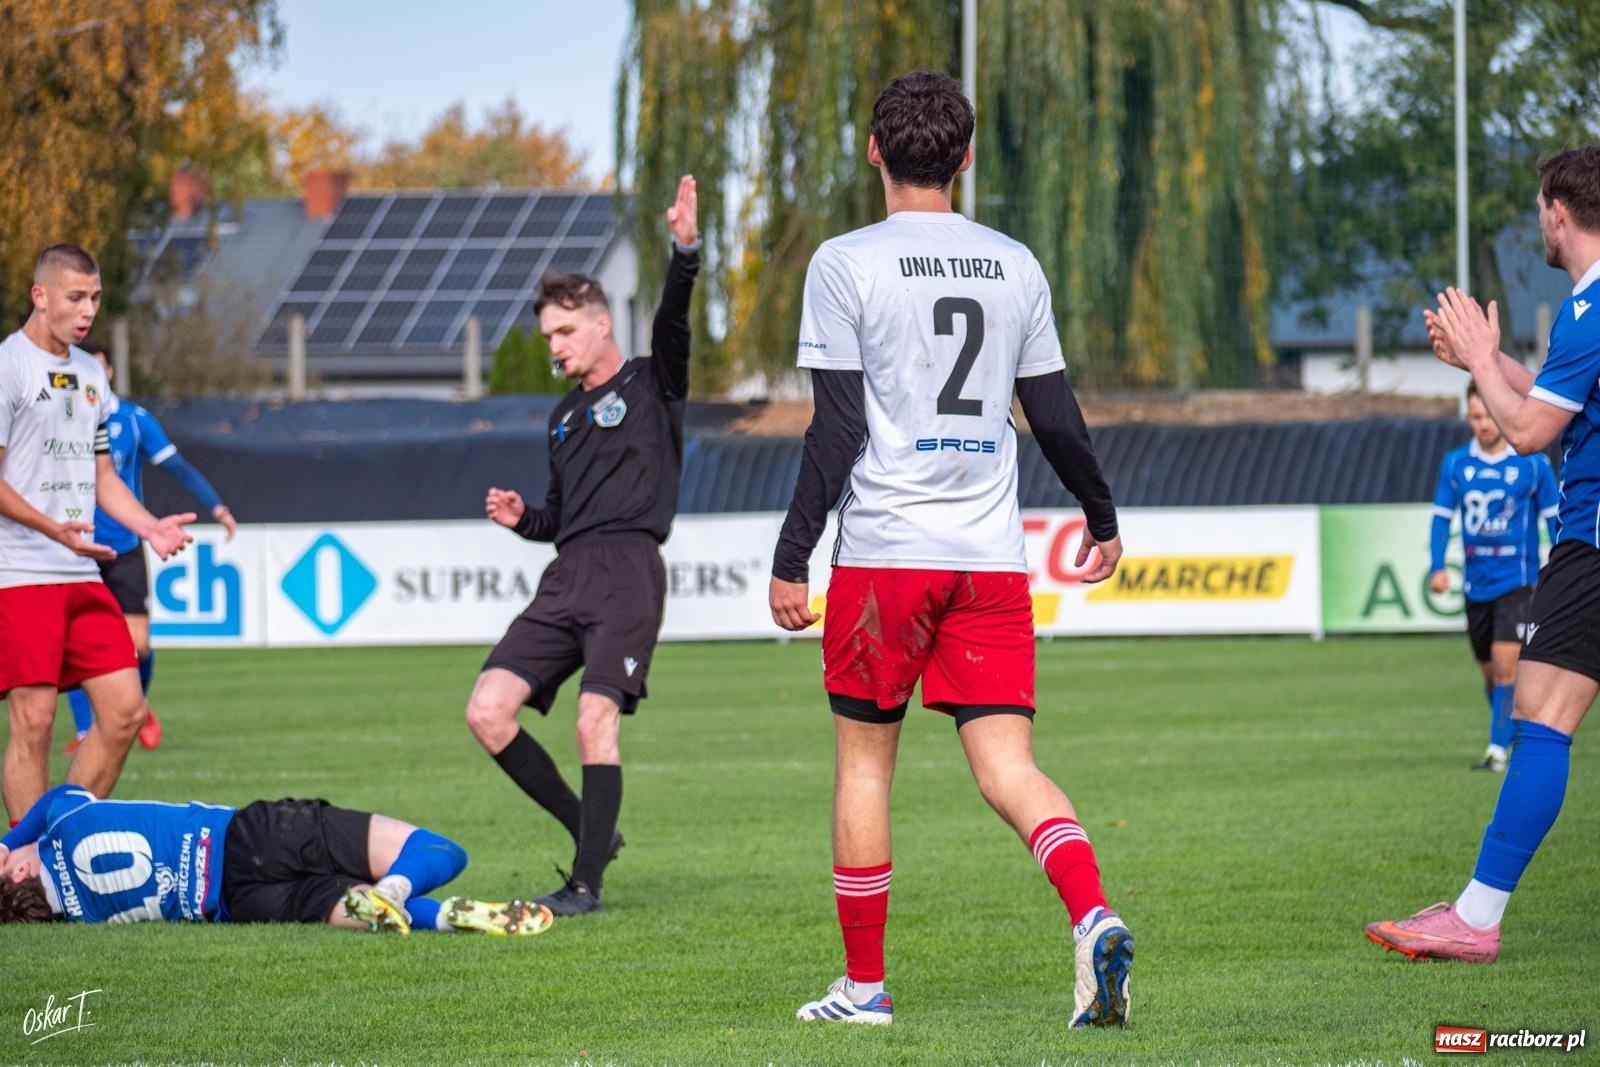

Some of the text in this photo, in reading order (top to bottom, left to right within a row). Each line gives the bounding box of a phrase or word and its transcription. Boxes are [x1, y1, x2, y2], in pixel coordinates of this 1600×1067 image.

[899, 257, 1005, 281] UNIA TURZA
[933, 296, 985, 417] 2
[916, 438, 996, 454] GROS
[393, 566, 532, 603] SUPRA
